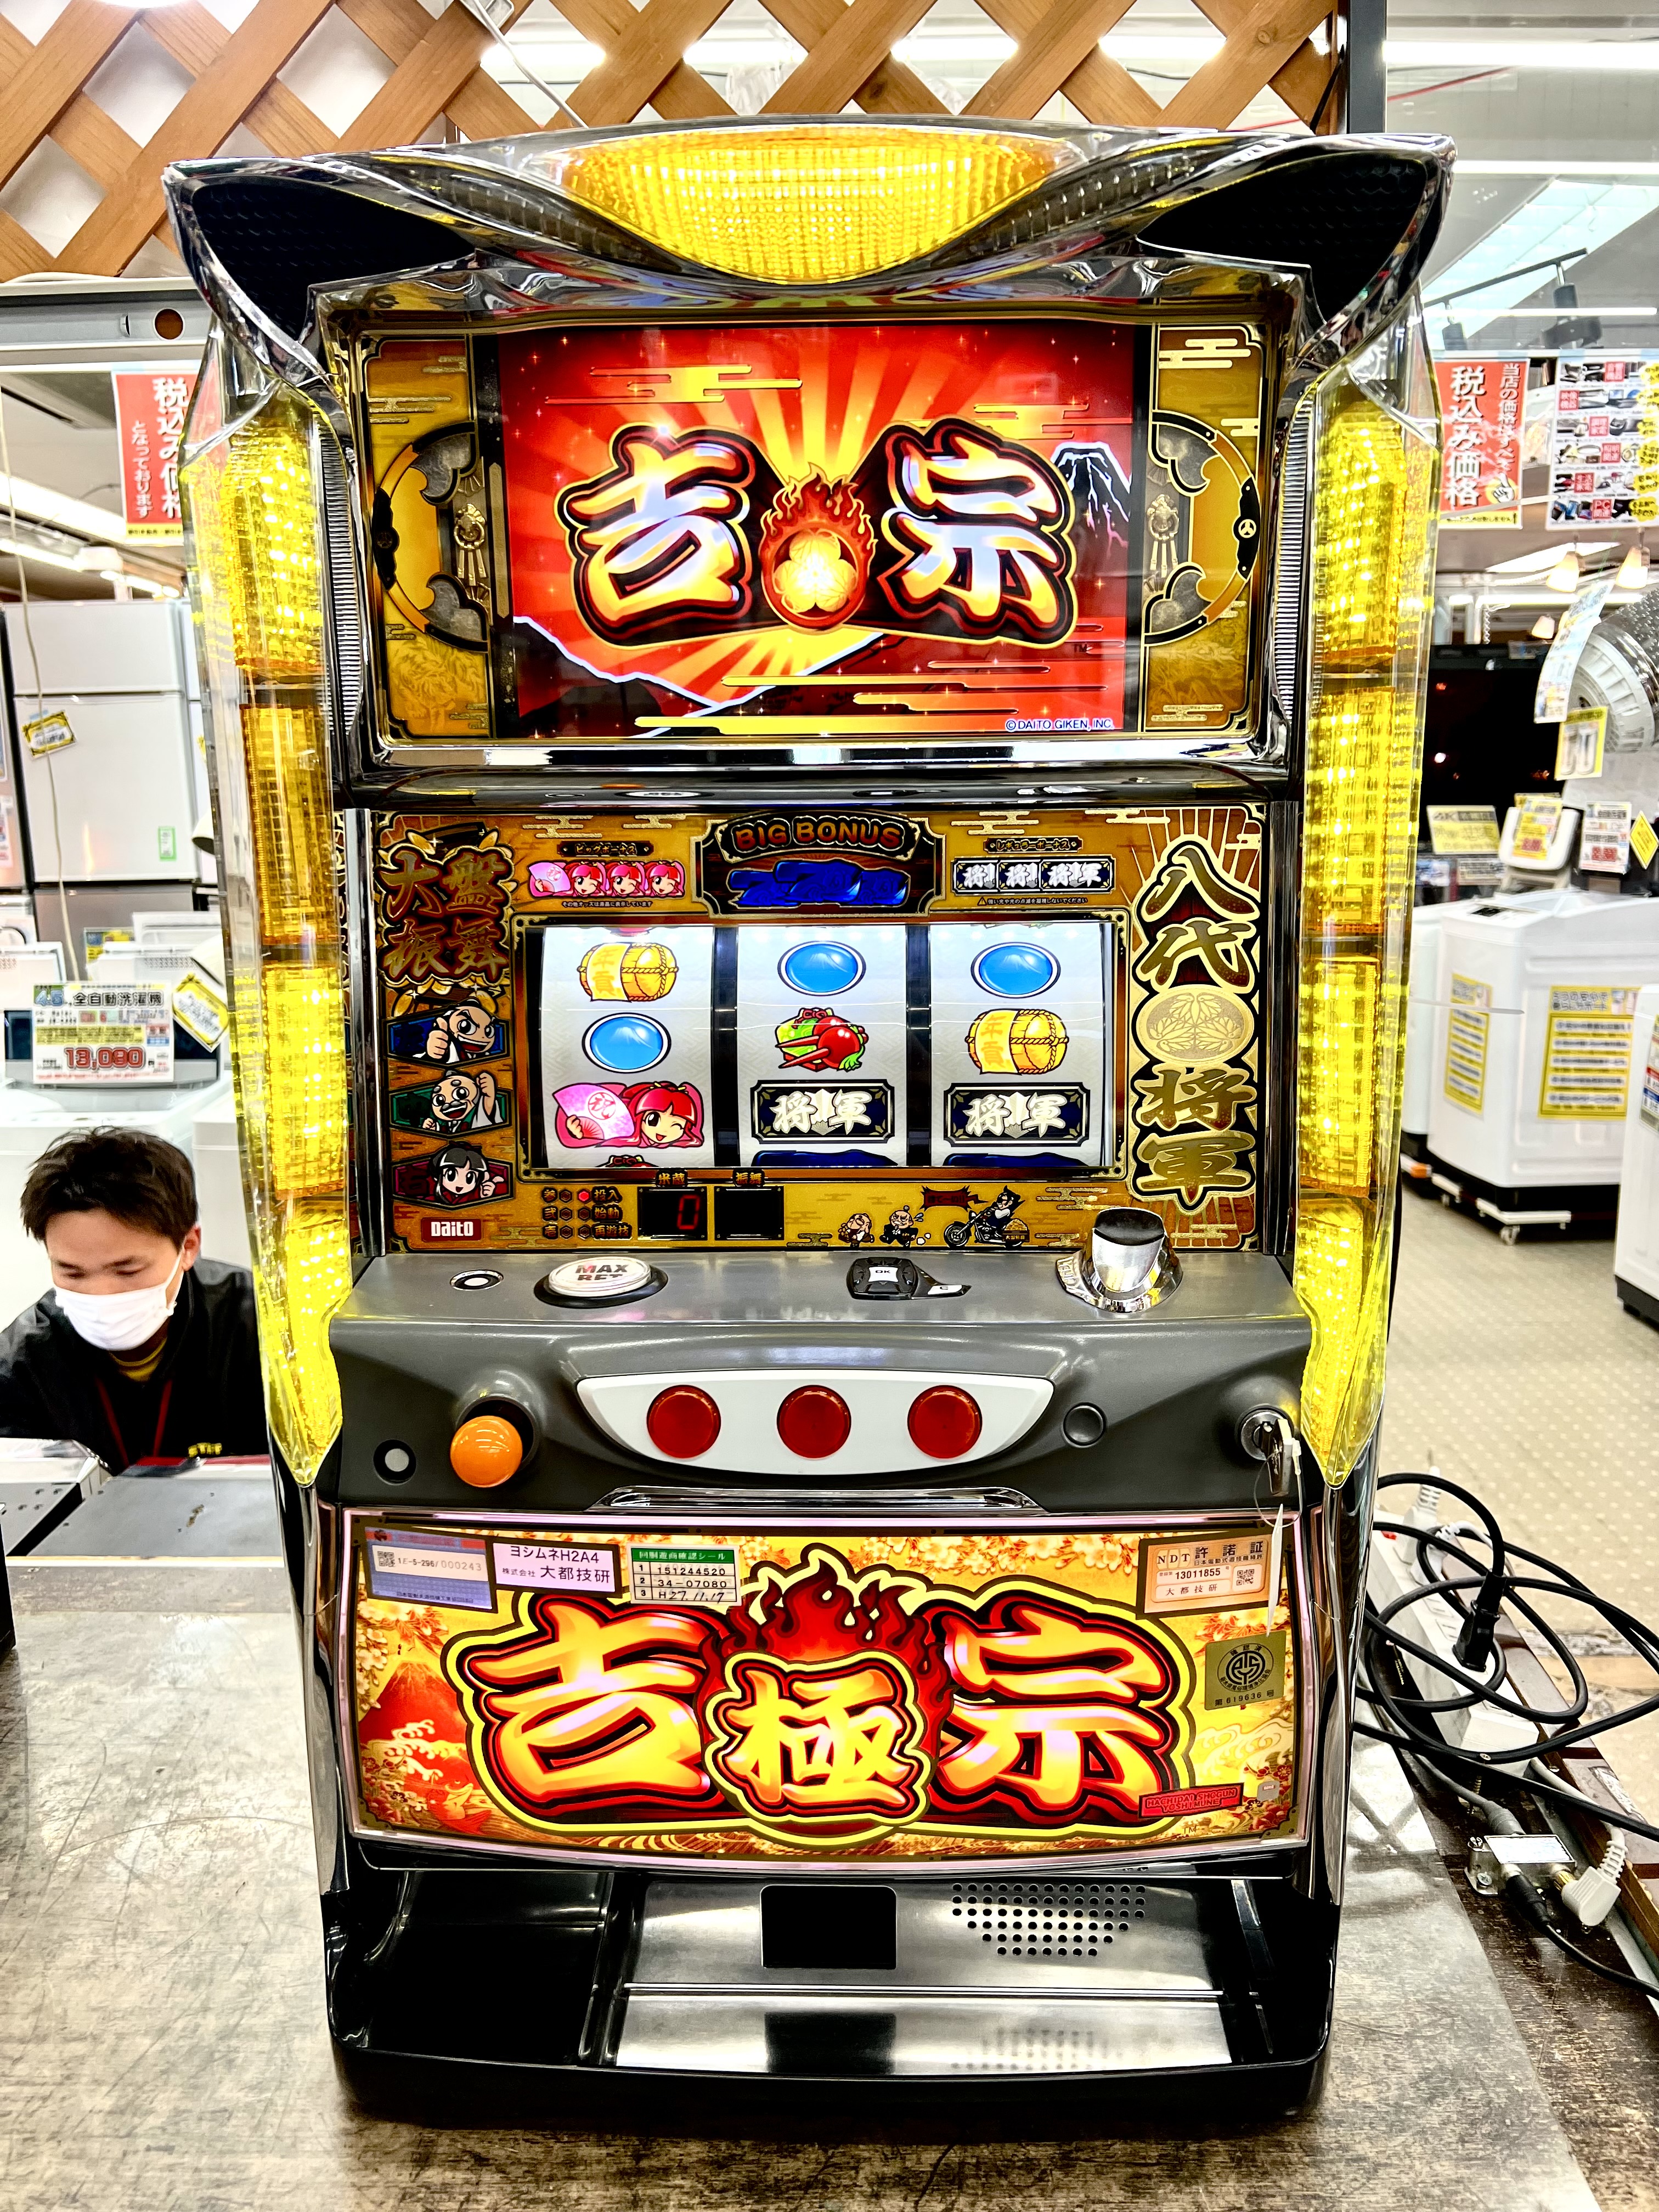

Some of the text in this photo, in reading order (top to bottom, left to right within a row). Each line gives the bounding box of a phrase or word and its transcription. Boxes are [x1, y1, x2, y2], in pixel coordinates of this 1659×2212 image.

[1444, 365, 1486, 508] 税込み価格
[132, 420, 154, 519] となっております
[1595, 500, 1611, 509] PC
[561, 431, 1067, 631] 吉宗
[736, 821, 901, 849] BIG BONUS
[576, 843, 637, 855] ビッグボーナス
[996, 839, 1070, 851] レギュラーボーナス
[381, 850, 507, 918] 大盤
[73, 992, 164, 1007] 全自動洗濯機
[770, 1090, 873, 1135] 将軍
[964, 1091, 1068, 1138] 将軍
[594, 1188, 620, 1202] 投入
[594, 1206, 620, 1221] 始動
[594, 1224, 630, 1238] 再遊技
[575, 1264, 629, 1273] MAX
[510, 1545, 600, 1564] ヨシムネH2A4
[639, 1551, 725, 1560] 回胴遊商確認シール
[1157, 1541, 1263, 1564] NDT 許諾証
[1194, 1554, 1262, 1566] 日本電動式遊技機特許
[502, 1565, 610, 1583] 株式会社 大都技研
[658, 1567, 725, 1576] 151244520
[1175, 1567, 1221, 1580] 13011855
[1166, 1584, 1217, 1596] 大都技研
[1147, 1788, 1236, 1808] HACHIDAI SHOGUN
[1163, 1798, 1220, 1811] YOSHIMUNE
